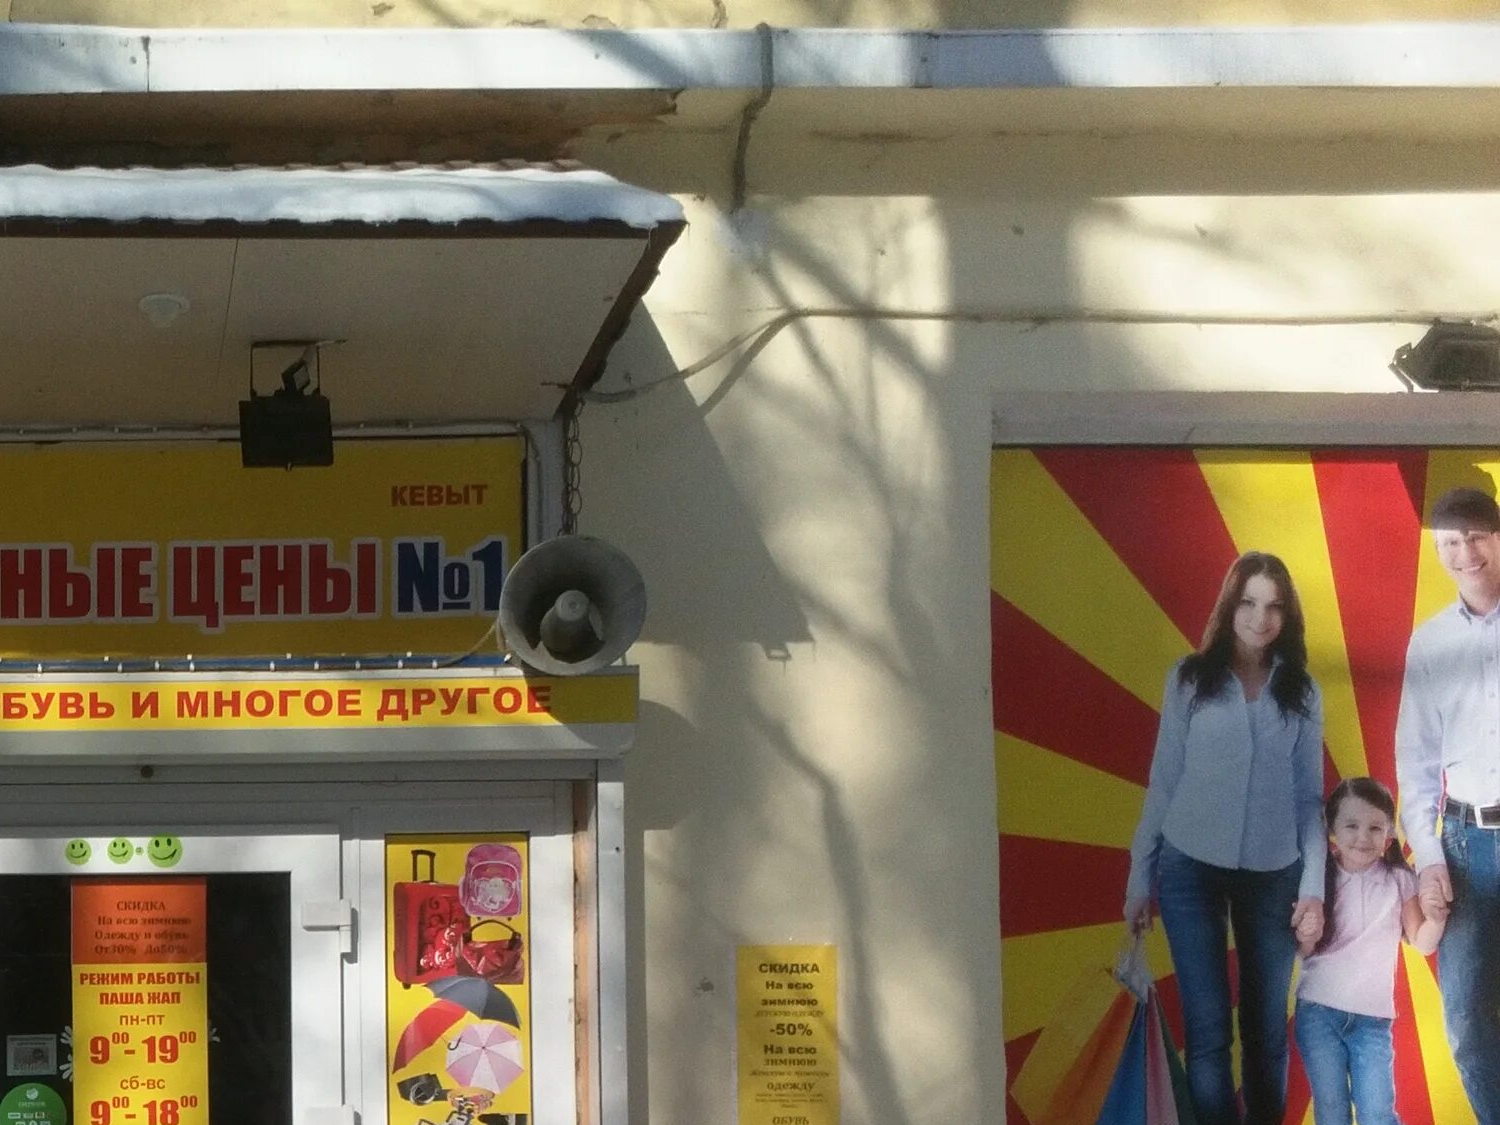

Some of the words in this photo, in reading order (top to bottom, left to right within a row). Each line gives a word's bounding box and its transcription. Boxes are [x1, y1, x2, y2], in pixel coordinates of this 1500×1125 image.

[390, 484, 488, 507] КЕВЫТ
[172, 542, 378, 628] ЦЕНЫ
[396, 540, 504, 614] №1
[131, 690, 160, 719] И
[176, 688, 363, 719] МНОГОЕ
[376, 685, 553, 722] ДРУГОЕ
[116, 900, 166, 912] СКИДКА
[94, 930, 140, 942] Одежду
[758, 963, 820, 975] СКИДКА
[79, 972, 133, 985] РЕЖИМ
[137, 972, 200, 985] РАБОТЫ
[765, 981, 783, 990] На
[787, 981, 814, 990] всю
[99, 992, 144, 1005] ПАША
[147, 991, 181, 1004] ЖАП
[770, 1023, 813, 1036] -50%
[763, 1044, 784, 1055] На
[788, 1046, 817, 1055] всю
